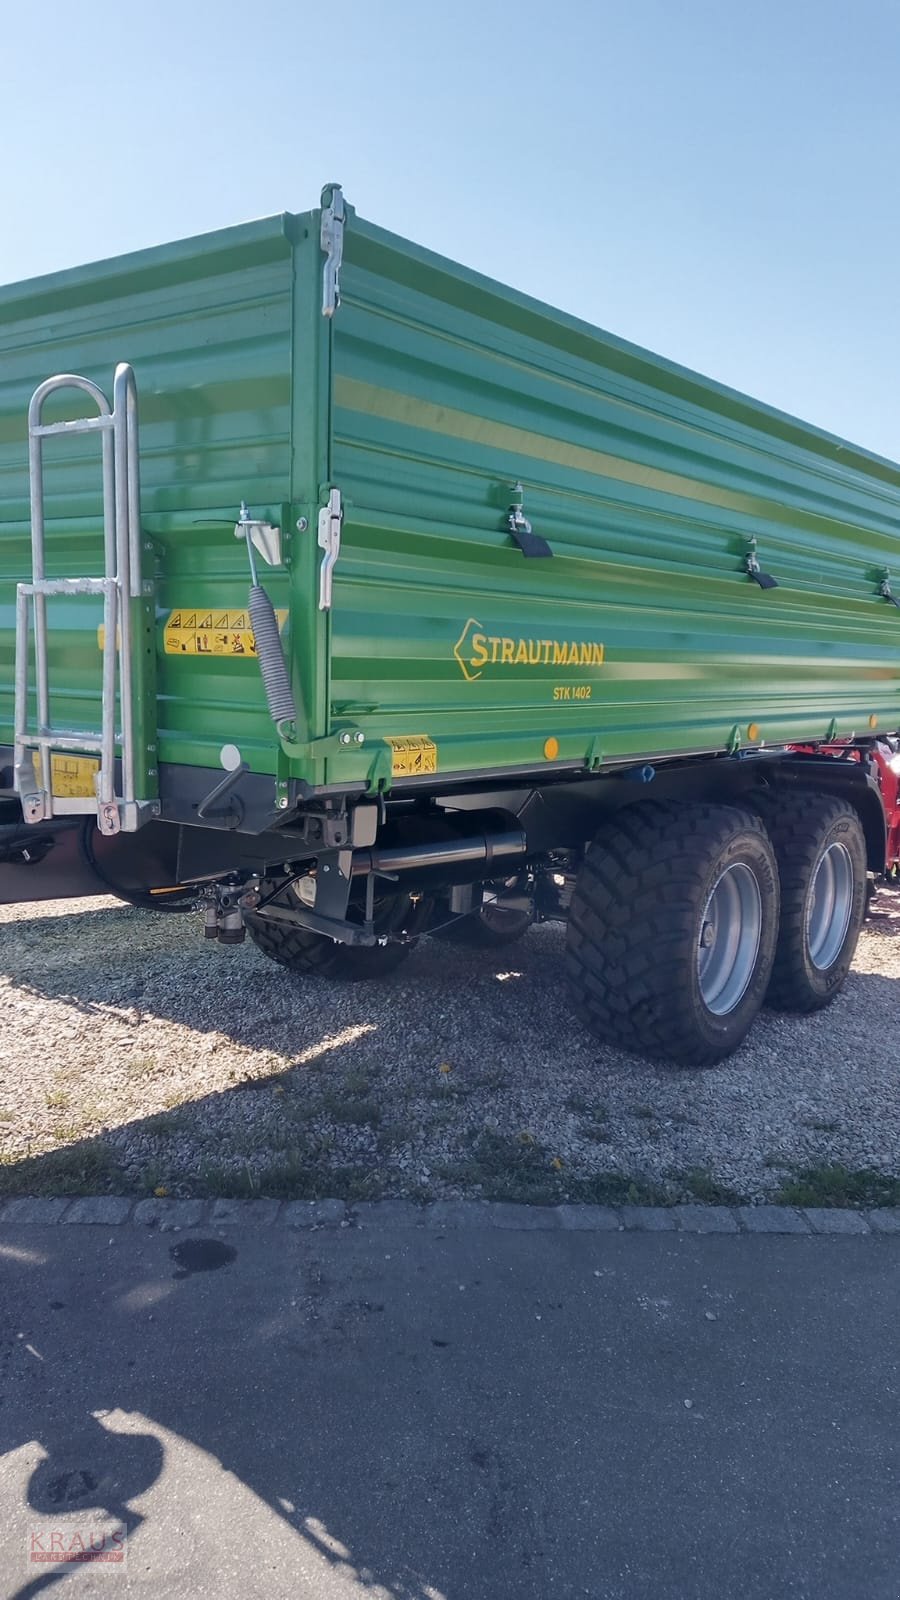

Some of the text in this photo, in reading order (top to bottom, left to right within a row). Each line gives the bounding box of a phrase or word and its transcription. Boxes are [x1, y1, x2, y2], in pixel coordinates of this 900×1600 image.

[470, 634, 605, 667] STRAUTMANN
[553, 686, 592, 700] STK 1402
